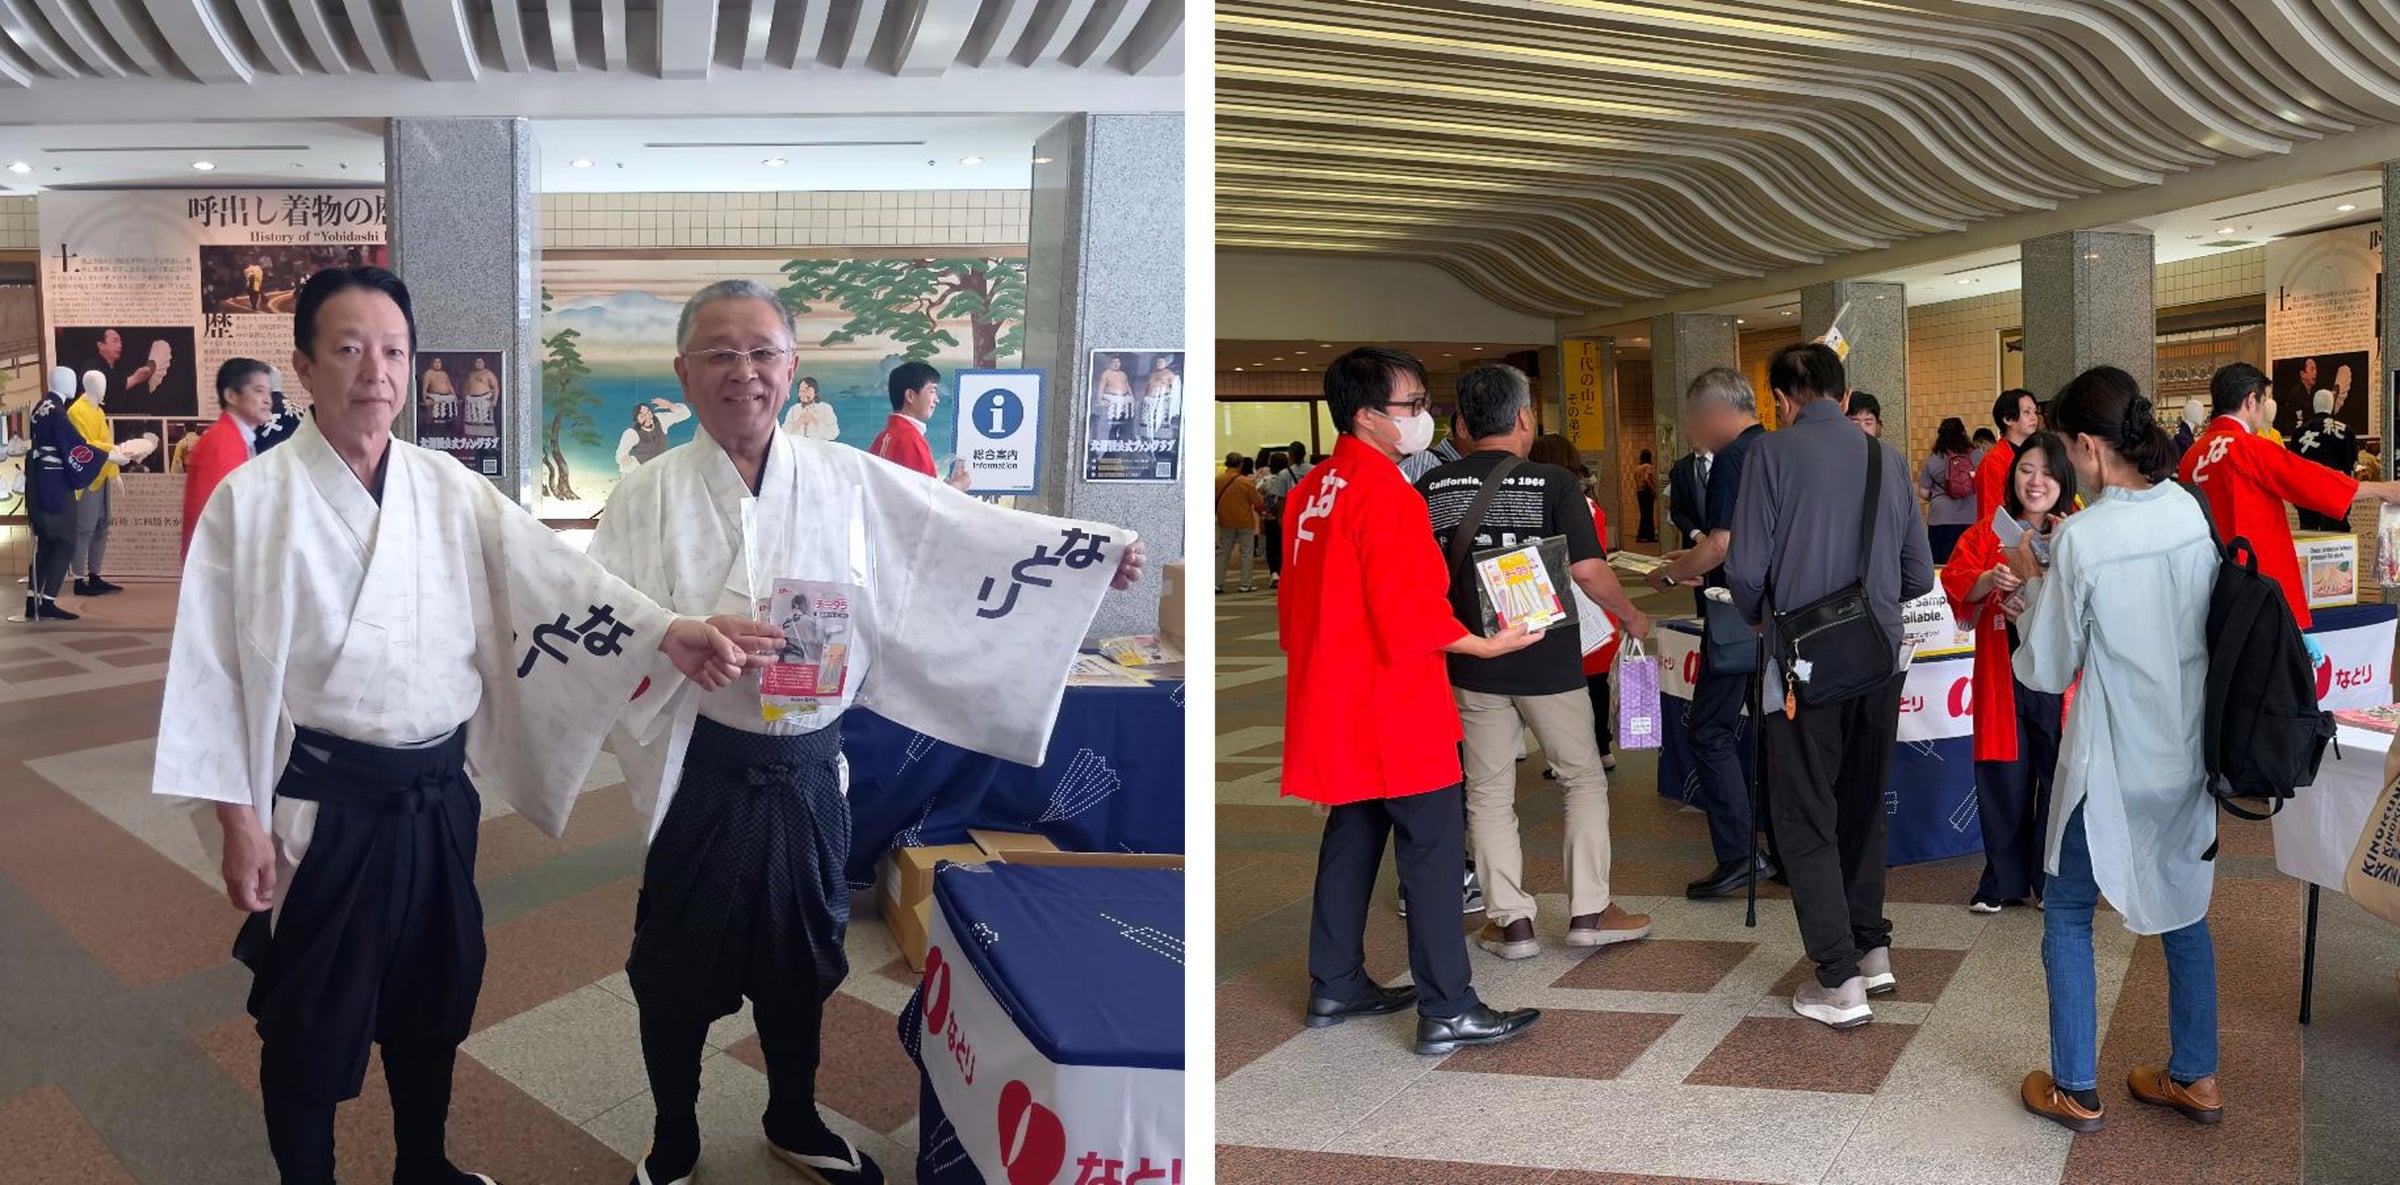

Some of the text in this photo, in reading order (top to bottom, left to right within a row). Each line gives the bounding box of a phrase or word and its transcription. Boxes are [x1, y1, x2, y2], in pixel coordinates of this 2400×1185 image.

[250, 231, 294, 243] History
[299, 231, 310, 241] of
[973, 449, 1018, 460] 総合案内
[973, 461, 1018, 469] Information
[1428, 475, 1483, 491] California,
[976, 528, 1111, 619] なとり
[1903, 612, 1944, 625] ailable.
[2335, 664, 2372, 689] なとり
[1898, 696, 1923, 712] とり
